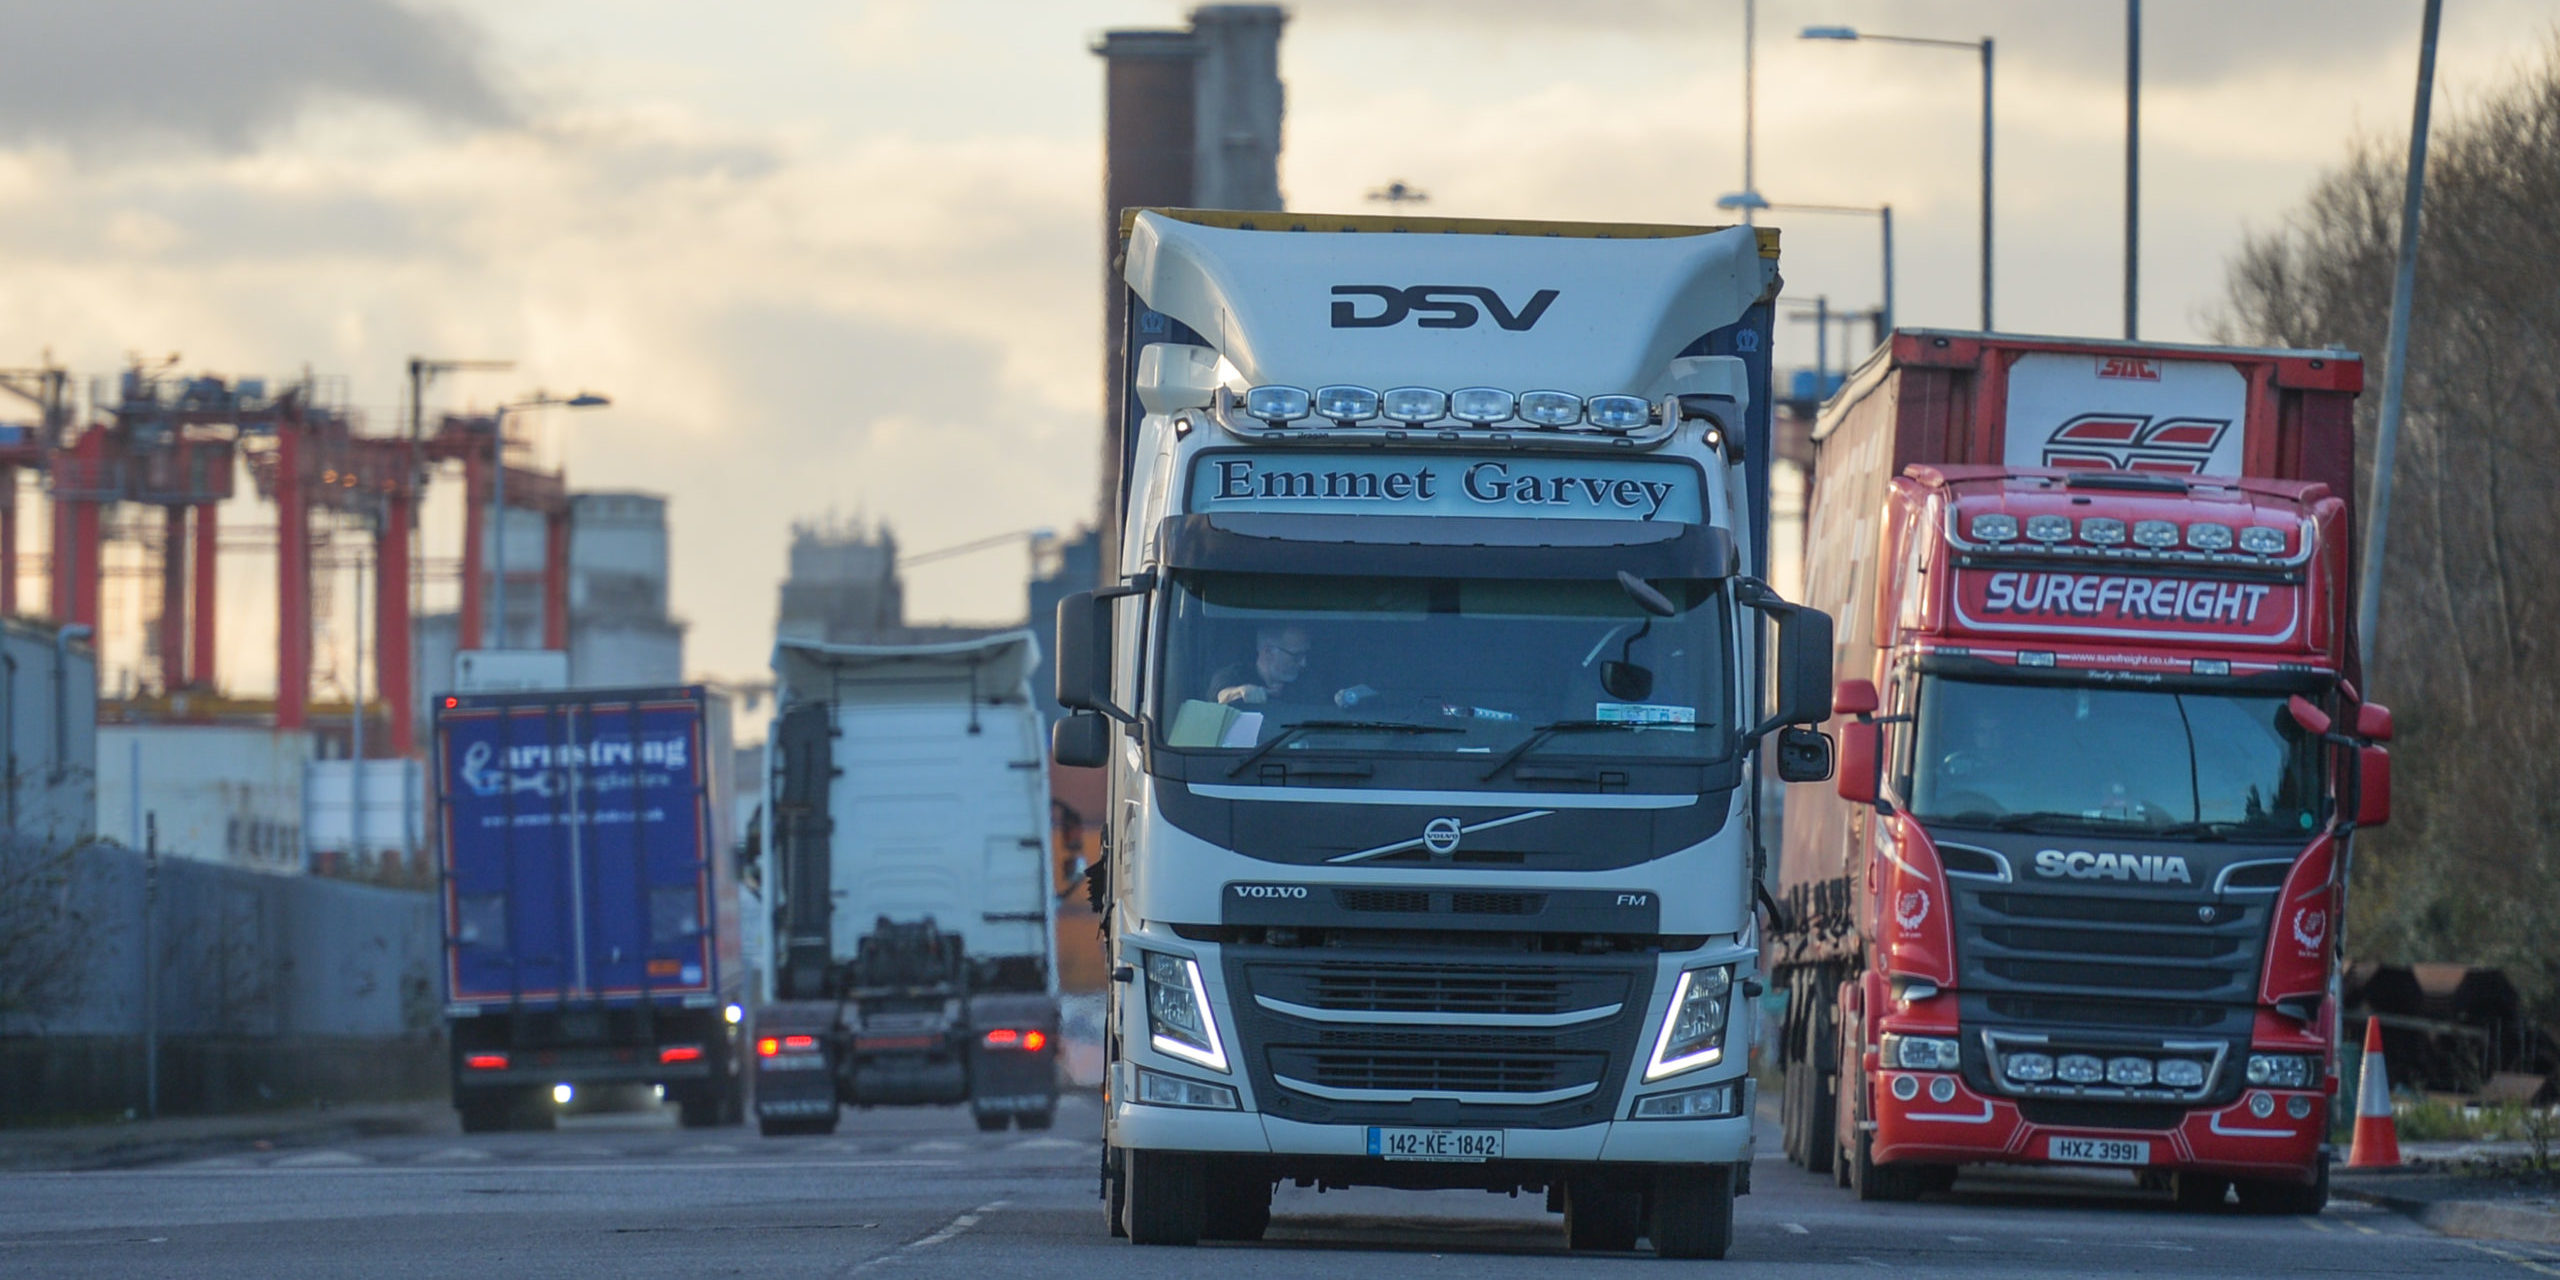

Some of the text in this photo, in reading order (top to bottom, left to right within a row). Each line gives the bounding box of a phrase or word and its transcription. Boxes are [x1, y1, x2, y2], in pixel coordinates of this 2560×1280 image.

[1331, 285, 1560, 331] DSV
[1212, 459, 1674, 522] Emmet Garvey
[1984, 572, 2270, 623] SUREFREIGHT
[1425, 832, 1459, 841] VOLVO
[2034, 849, 2192, 884] SCANIA
[1233, 885, 1308, 899] VOLVO
[1616, 894, 1647, 906] FM
[1389, 1133, 1496, 1155] 142-KE-1842
[2060, 1140, 2139, 1160] HXZ 3991
